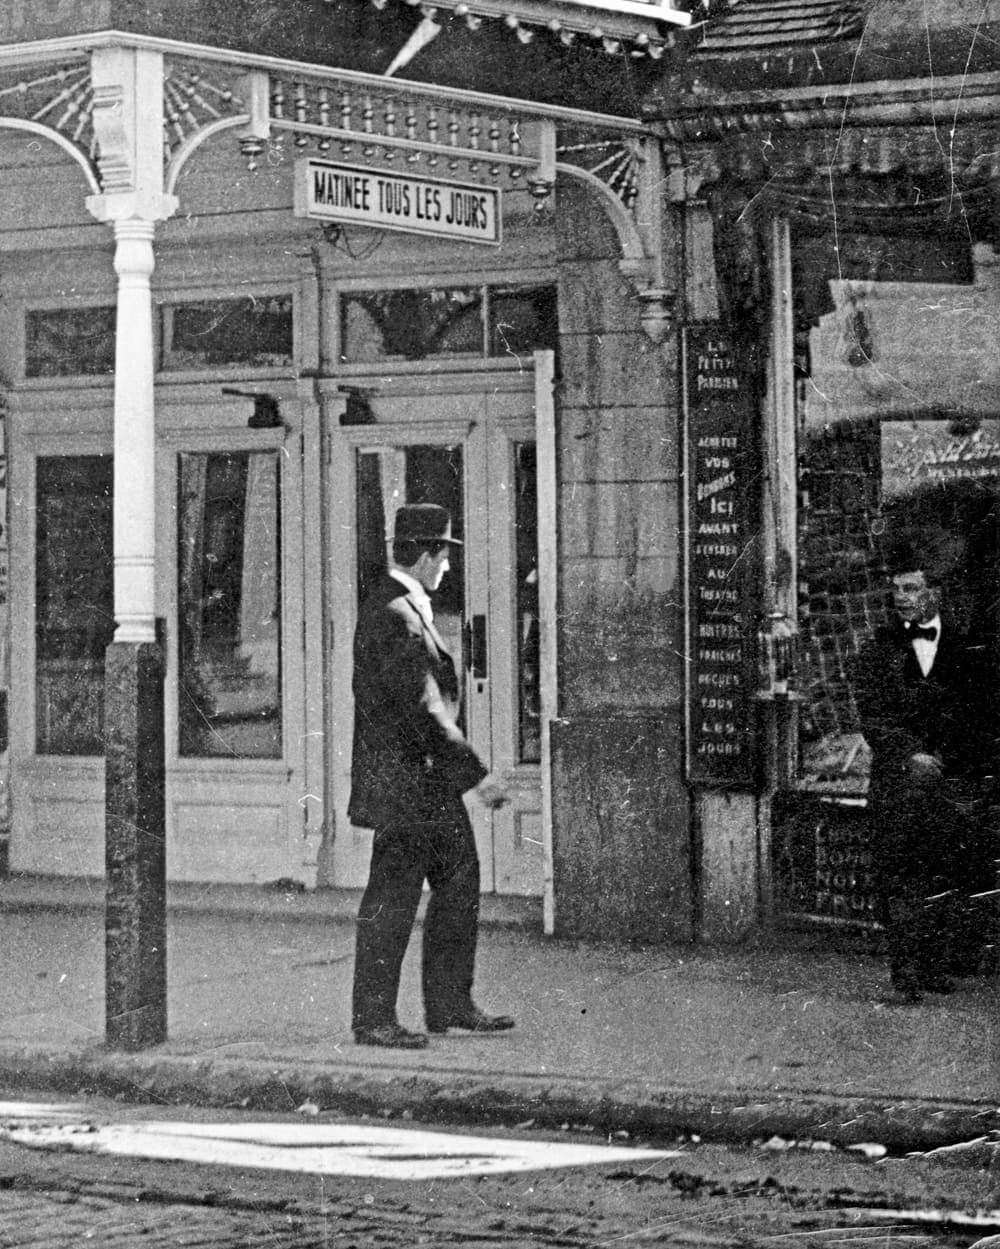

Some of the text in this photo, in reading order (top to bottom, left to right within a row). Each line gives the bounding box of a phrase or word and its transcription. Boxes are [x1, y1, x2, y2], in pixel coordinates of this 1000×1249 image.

[314, 170, 488, 230] MATINEE TOUS LES JOURS
[705, 457, 730, 469] VOS
[707, 569, 726, 580] AU
[702, 722, 735, 734] LES
